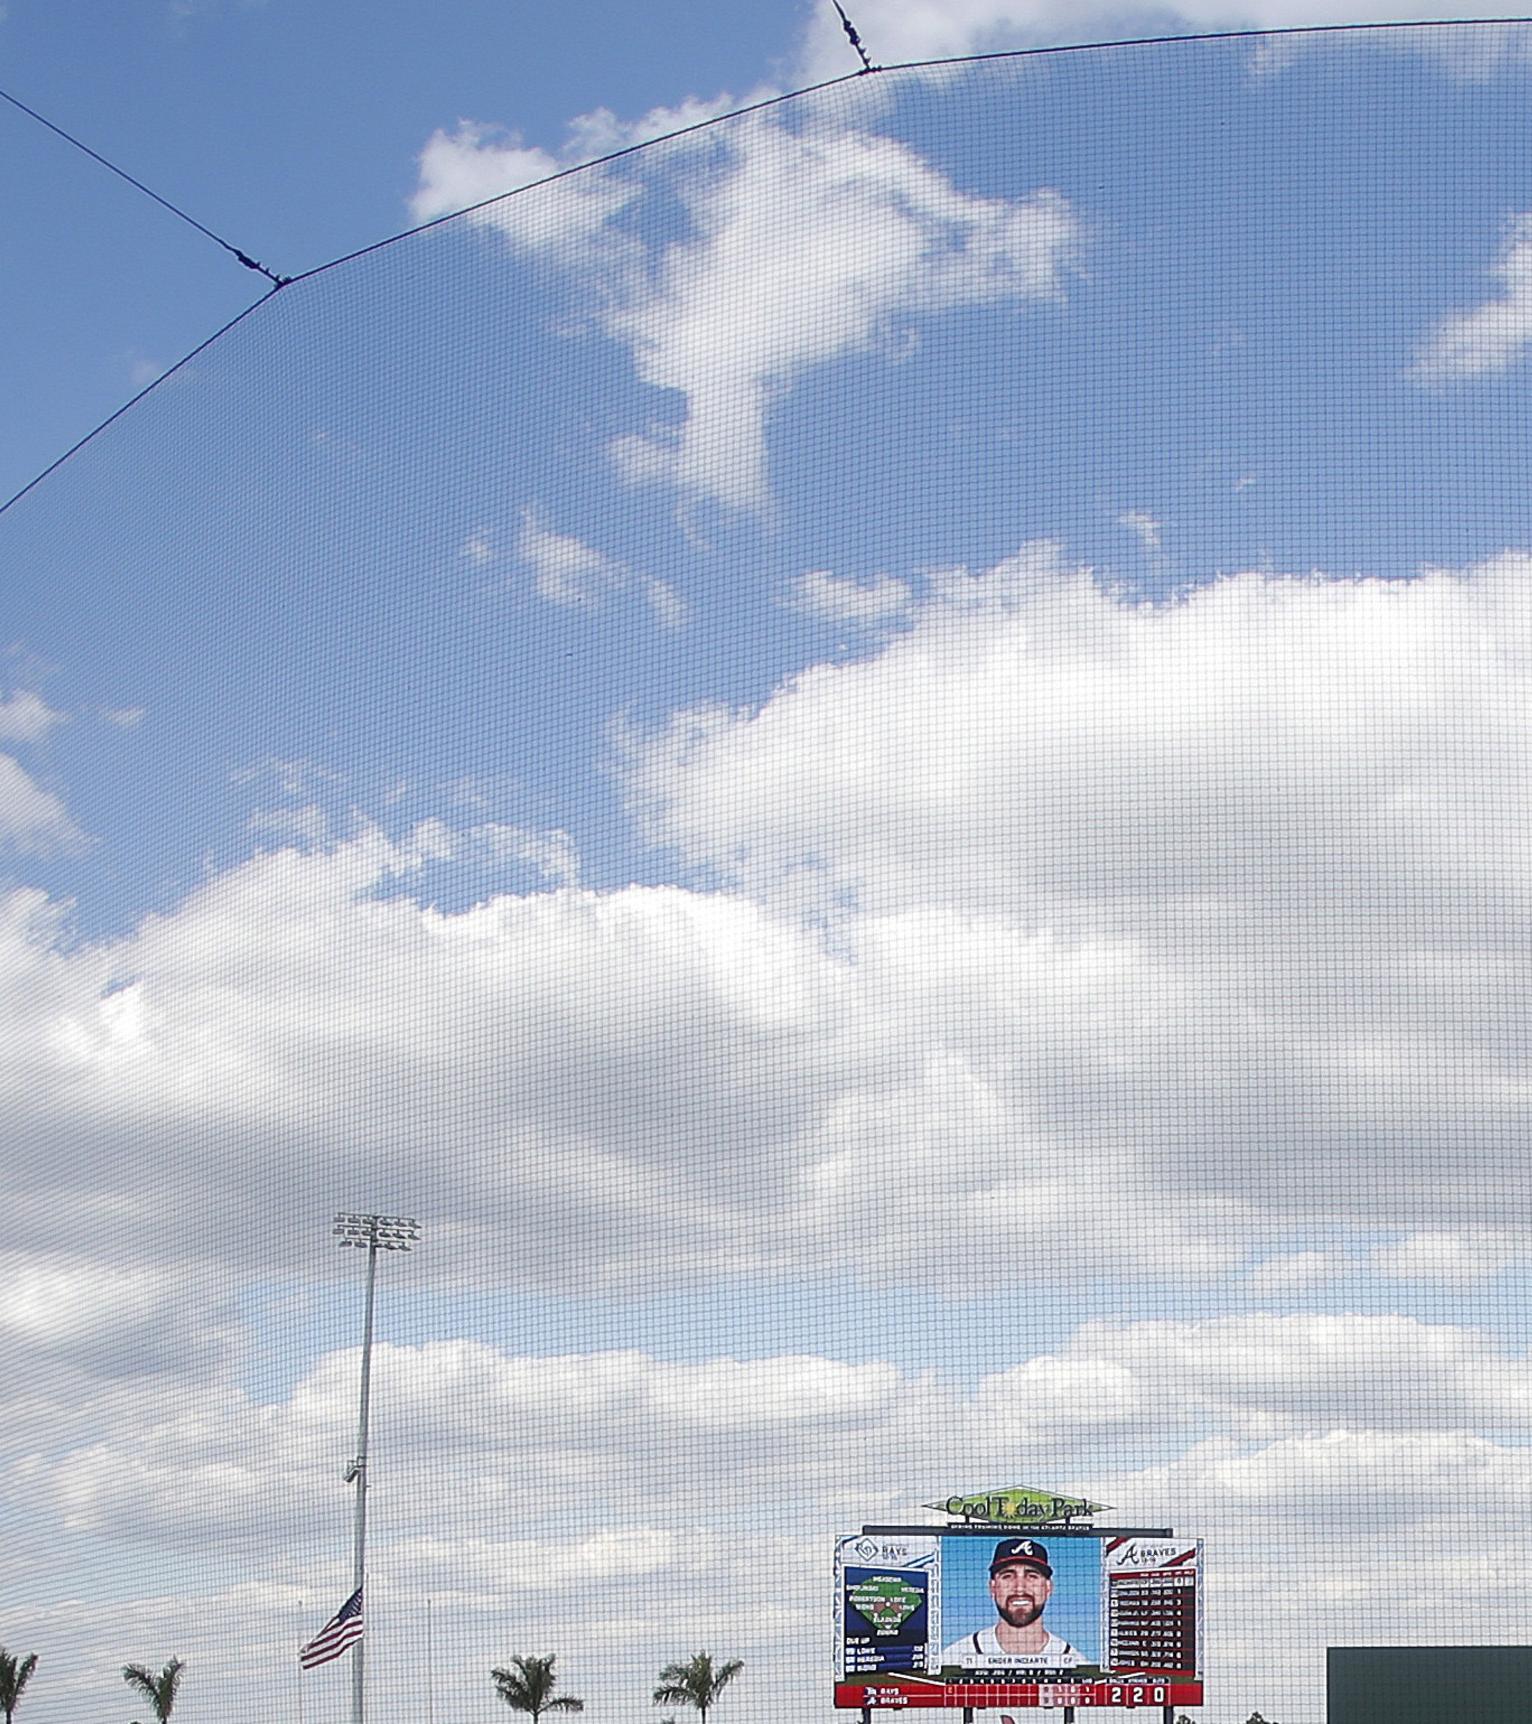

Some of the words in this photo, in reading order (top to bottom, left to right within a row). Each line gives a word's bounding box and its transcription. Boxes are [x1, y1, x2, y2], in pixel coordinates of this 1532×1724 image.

[1051, 1497, 1094, 1518] Park
[1141, 1548, 1177, 1557] BRAVES
[1111, 1687, 1122, 1703] 2
[1133, 1687, 1144, 1703] 2
[1154, 1687, 1166, 1703] 0
